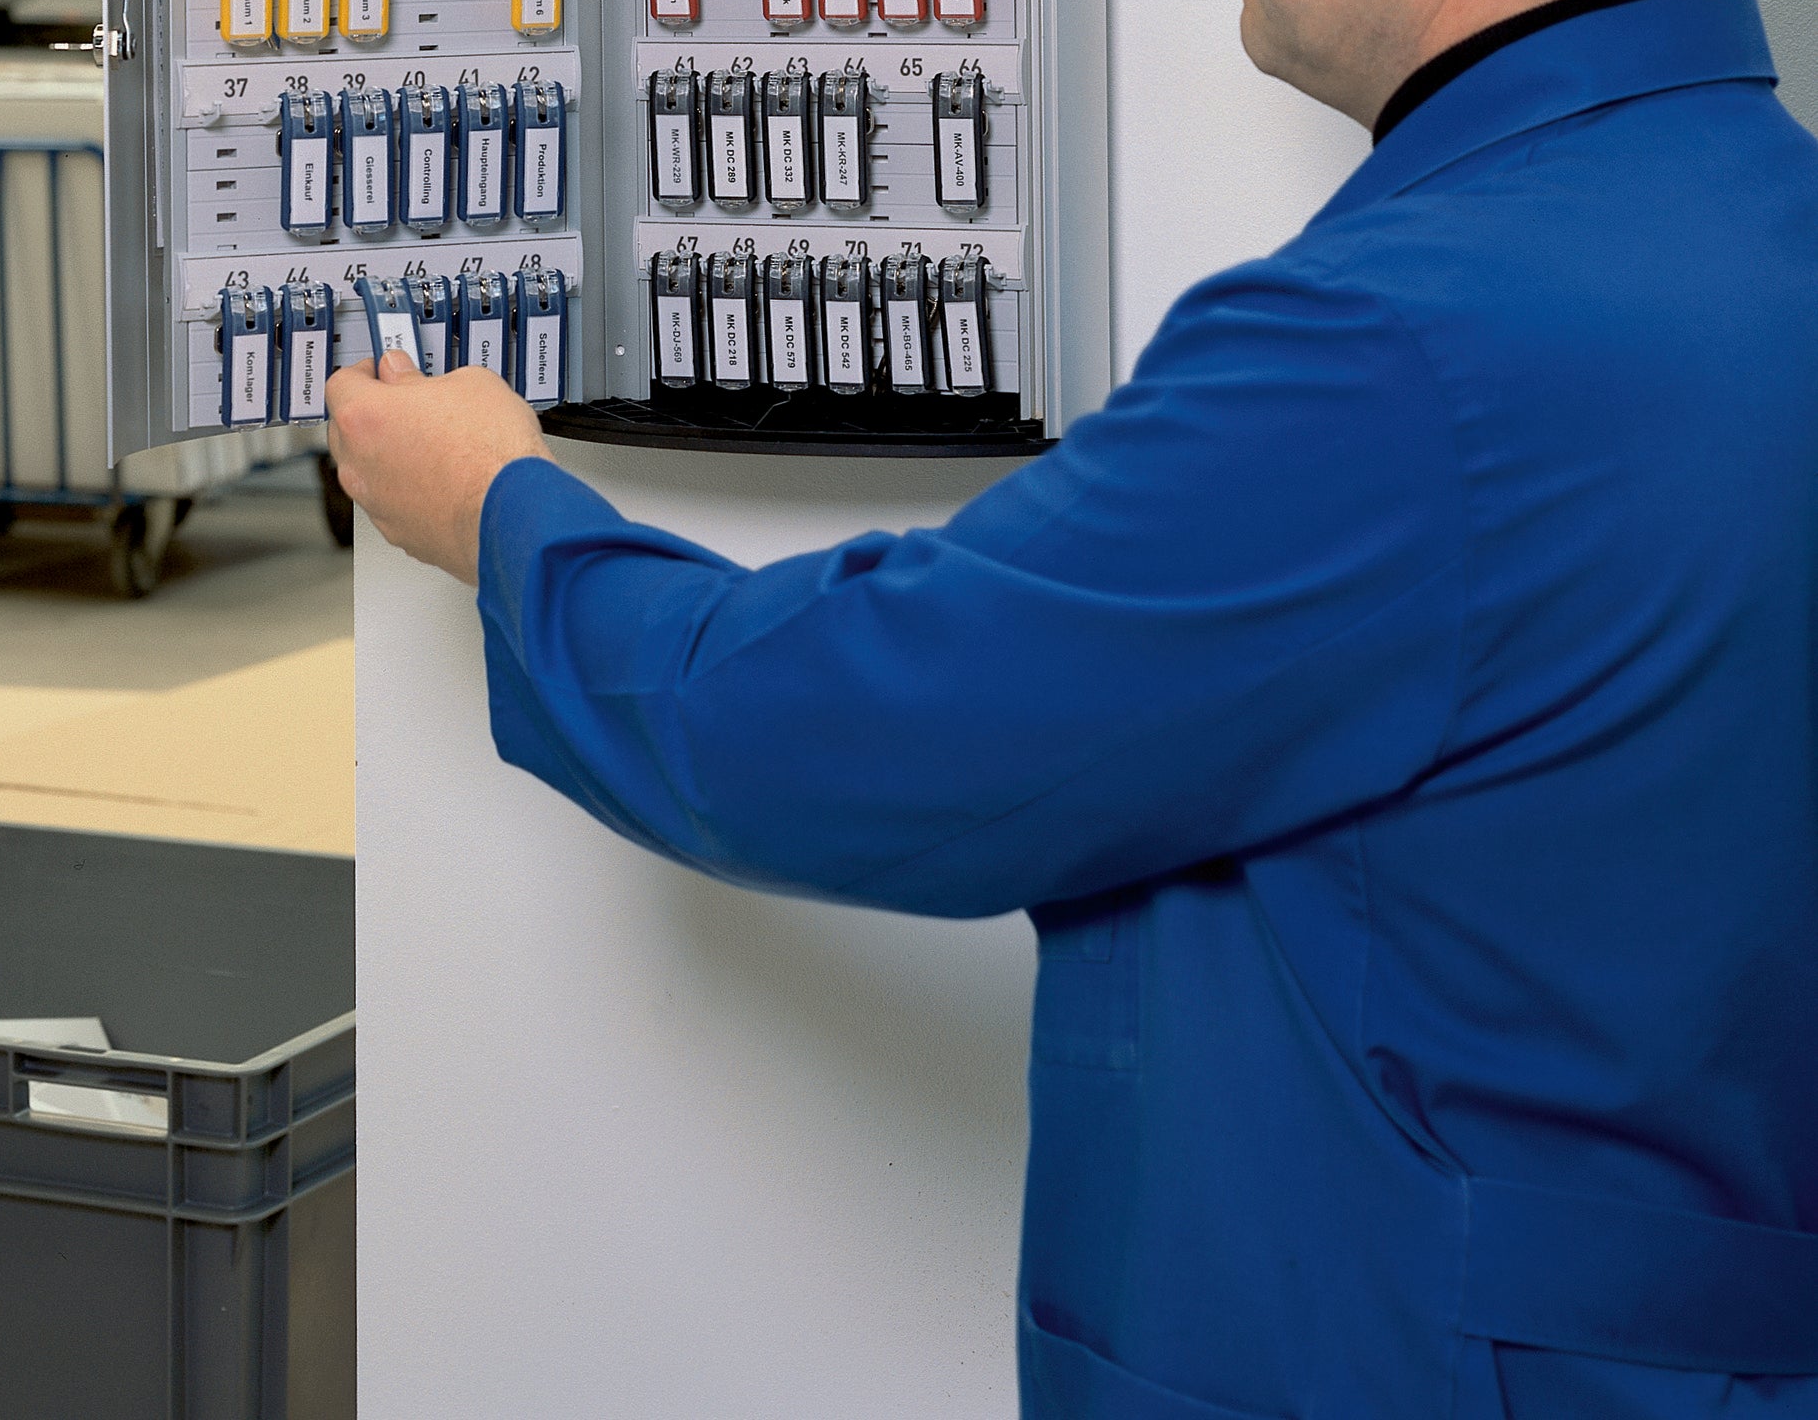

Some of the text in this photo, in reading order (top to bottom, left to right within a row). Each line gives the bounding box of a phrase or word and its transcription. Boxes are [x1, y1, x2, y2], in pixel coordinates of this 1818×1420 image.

[224, 78, 248, 98] 37
[343, 73, 366, 90] 39
[402, 70, 425, 89] 40
[458, 68, 479, 87] 41
[517, 66, 540, 84] 42
[900, 57, 923, 77] 65
[304, 162, 314, 202] Einkauf
[365, 155, 375, 204] Giesserei
[420, 148, 433, 205] Controlling
[478, 138, 491, 207] Haupteingang
[536, 143, 548, 198] Produktion
[671, 128, 682, 184] MK-WR-229
[725, 131, 736, 184] MK DC 289
[782, 130, 794, 183] MK DC 332
[837, 131, 848, 186] MK-KR-247
[953, 132, 965, 187] MK-AV-400
[224, 270, 249, 290] 43
[285, 266, 310, 284] 44
[403, 260, 427, 279] 46
[460, 257, 483, 274] 47
[519, 253, 542, 272] 48
[676, 235, 699, 253] 67
[732, 237, 755, 254] 68
[787, 238, 810, 256] 69
[845, 240, 868, 258] 70
[424, 352, 434, 360] F
[537, 332, 548, 385] Schleiferei
[671, 312, 683, 363] MK-DJ-569
[726, 313, 738, 366] MK DC 218
[784, 316, 796, 369] MK DC 579
[840, 316, 851, 370] MK DC 542
[901, 315, 913, 371] MK-BG-465
[959, 318, 973, 373] MK DC 225
[244, 351, 256, 404] Kom.lager
[302, 340, 315, 406] Materiallager
[425, 361, 434, 370] &
